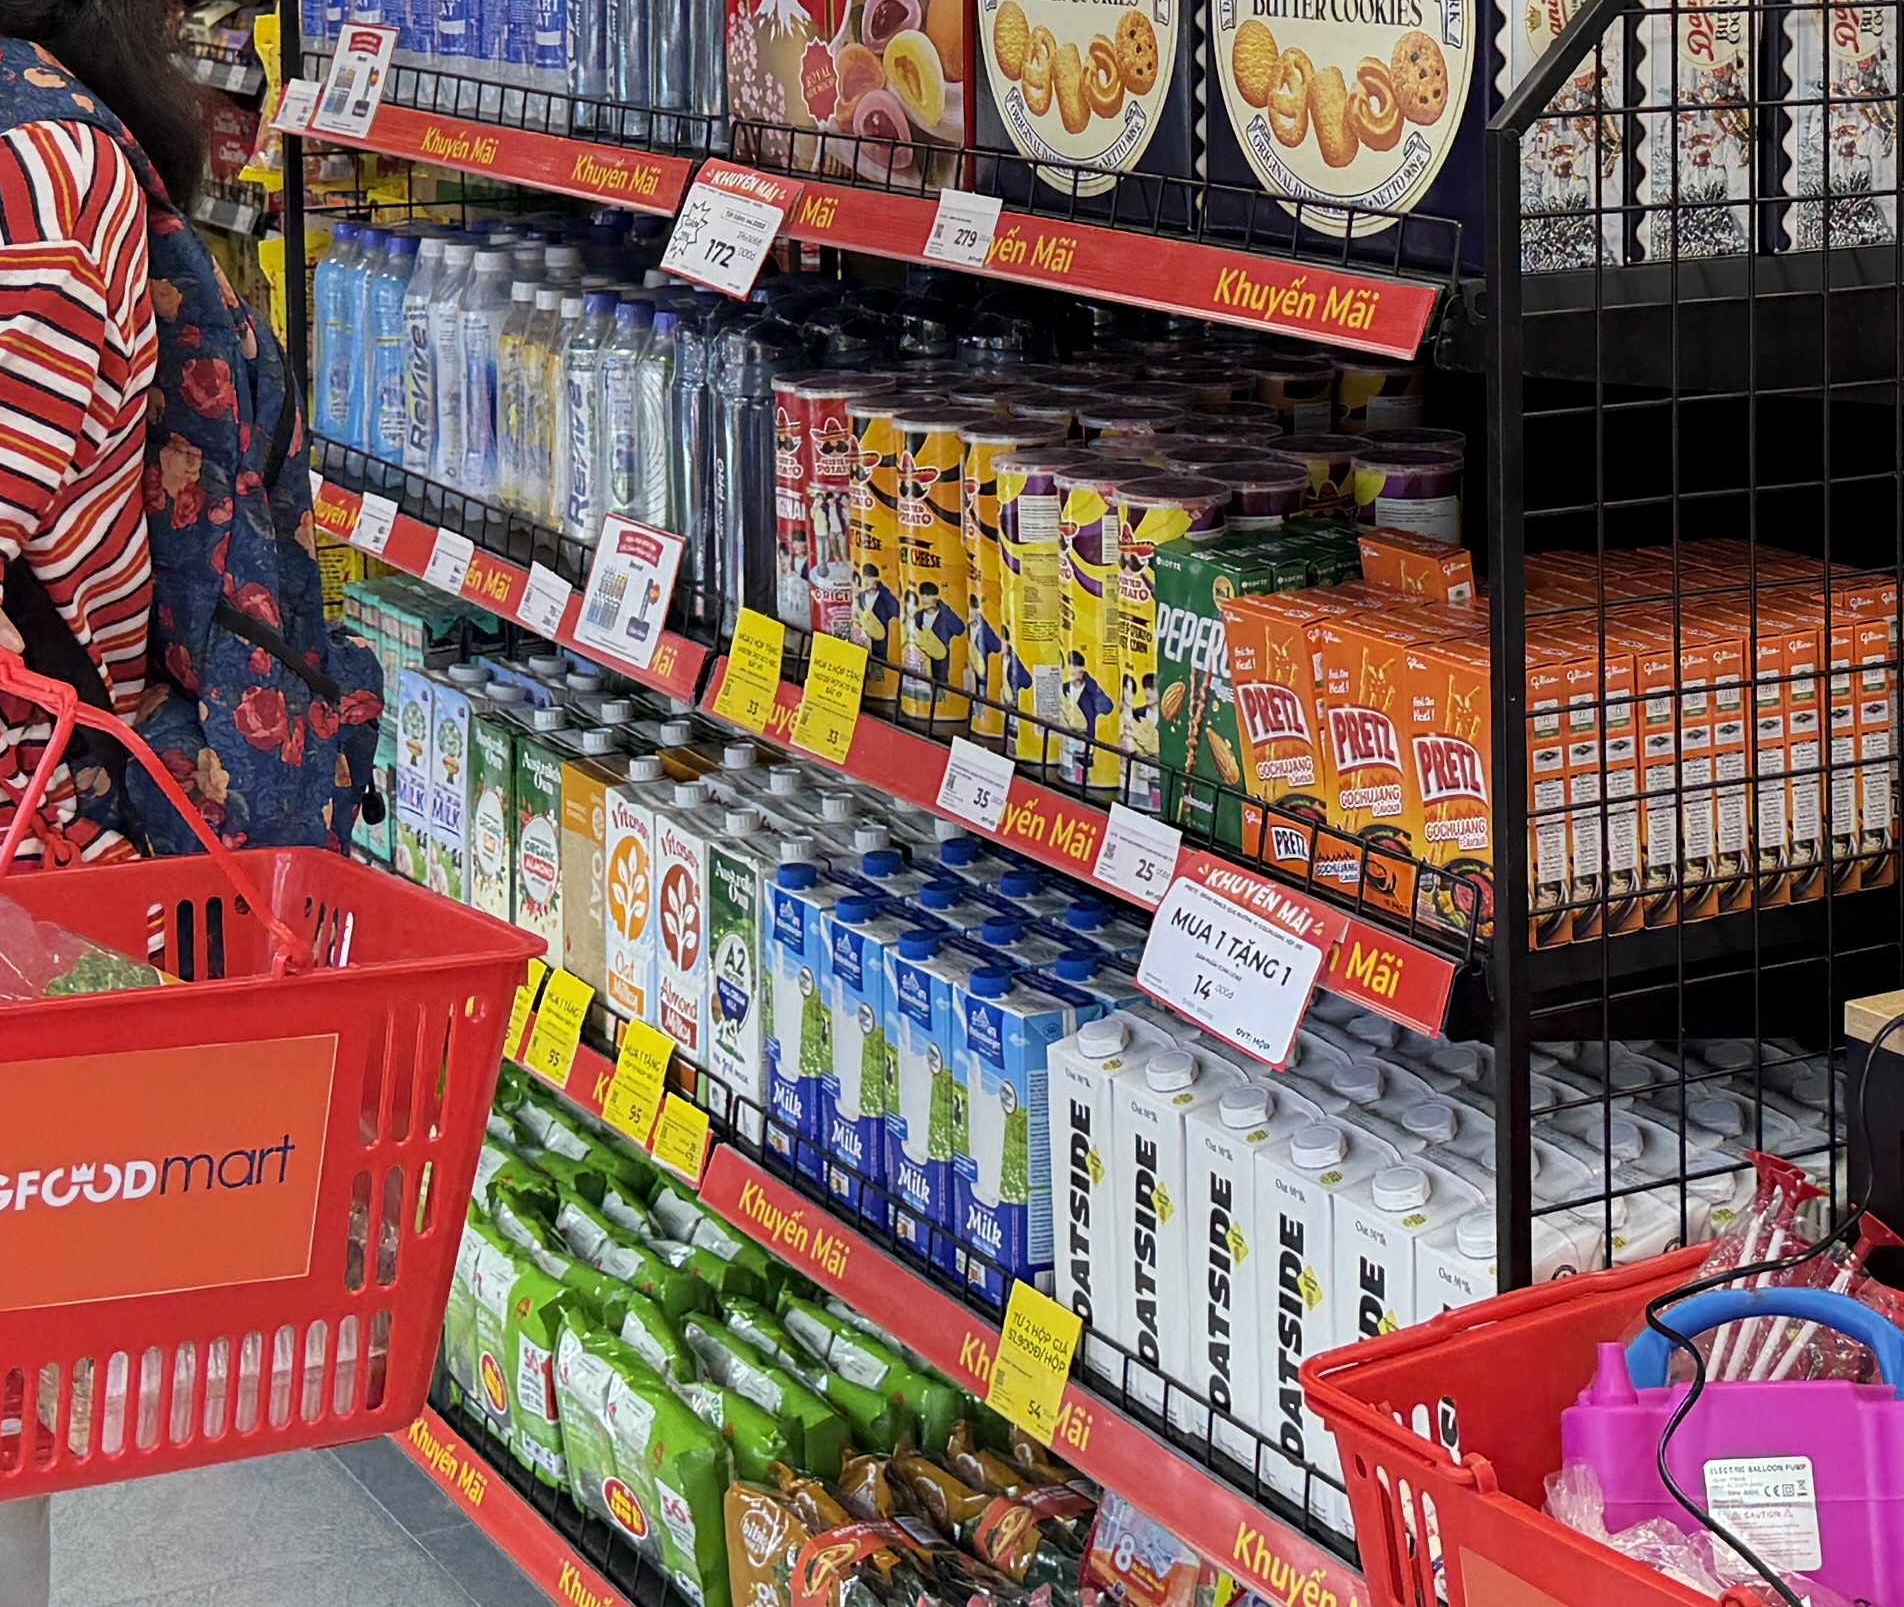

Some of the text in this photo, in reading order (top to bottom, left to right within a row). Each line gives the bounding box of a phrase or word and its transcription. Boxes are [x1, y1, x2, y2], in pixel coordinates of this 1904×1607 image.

[421, 125, 499, 165] Khuyến Mãi
[571, 152, 662, 197] Khuyến Mãi
[800, 195, 839, 229] Mãi
[704, 238, 735, 268] 172
[952, 226, 977, 249] 279
[1213, 267, 1381, 334] Khuyến Mãi
[1240, 683, 1305, 740] PRETZ
[1332, 709, 1395, 770] PRETZ
[1417, 738, 1483, 799] PRETZ
[972, 787, 991, 809] 35
[1274, 829, 1307, 859] PRETZ
[1135, 858, 1155, 883] 25
[725, 943, 747, 977] A2
[1171, 906, 1213, 945] MUA
[1215, 931, 1226, 951] 1
[1227, 937, 1279, 979] TẶNG
[1281, 966, 1292, 986] 1
[1193, 974, 1213, 1001] 14
[1345, 941, 1404, 1000] Mãi
[628, 1105, 643, 1125] 95
[832, 1120, 863, 1160] Milk
[899, 1162, 930, 1204] Milk
[739, 1179, 851, 1279] Khuyến Mãi
[967, 1205, 1002, 1250] Milk
[1208, 1171, 1234, 1415] OATSIDE
[1028, 1400, 1042, 1419] 54
[407, 1418, 488, 1508] Khuyến Mãi
[1748, 1464, 1783, 1473] BALLOON
[1744, 1511, 1781, 1520] CAUTION
